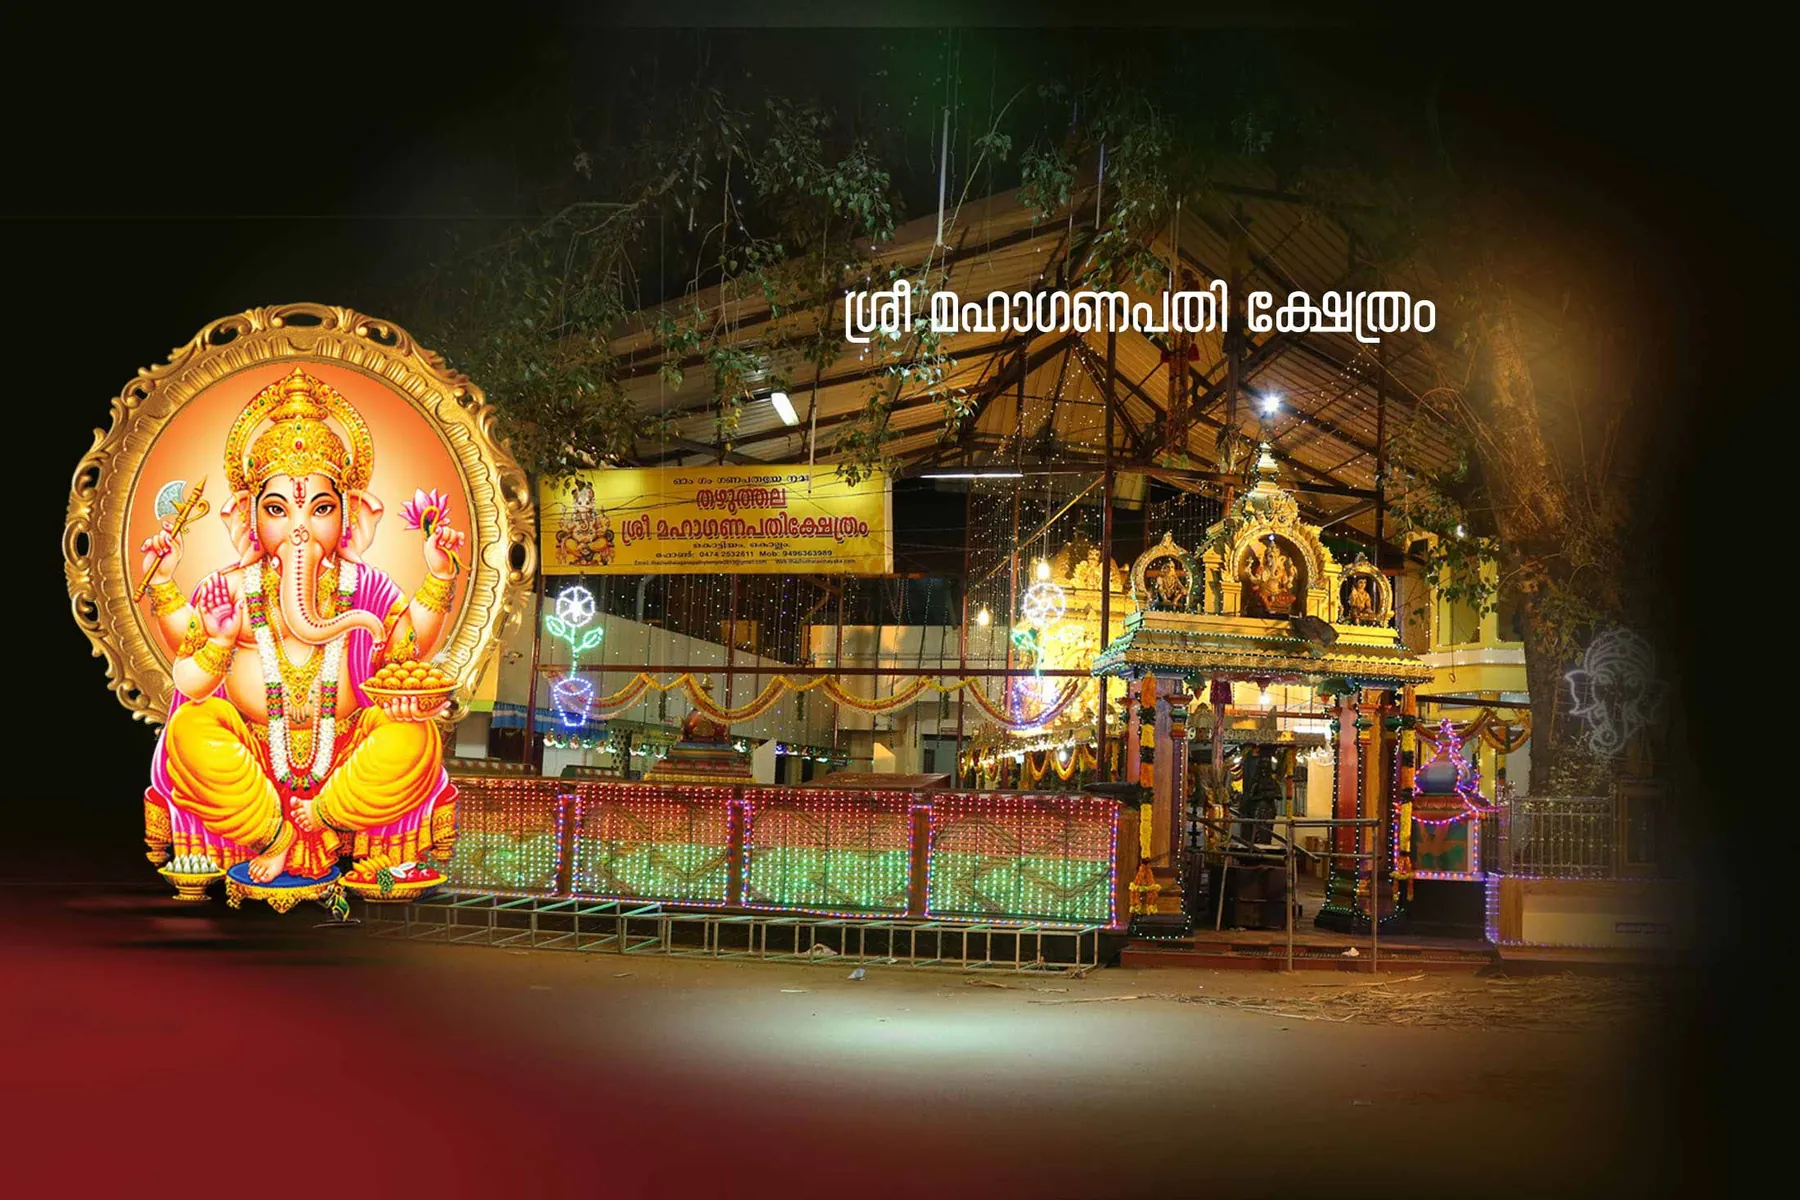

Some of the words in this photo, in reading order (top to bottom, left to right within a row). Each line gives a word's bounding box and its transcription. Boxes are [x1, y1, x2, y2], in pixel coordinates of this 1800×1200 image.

[696, 487, 787, 514] തഴുത്തല
[622, 513, 651, 545] ശ്രീ
[656, 511, 870, 543] മഹാഗണപതിക്ഷേത്രം
